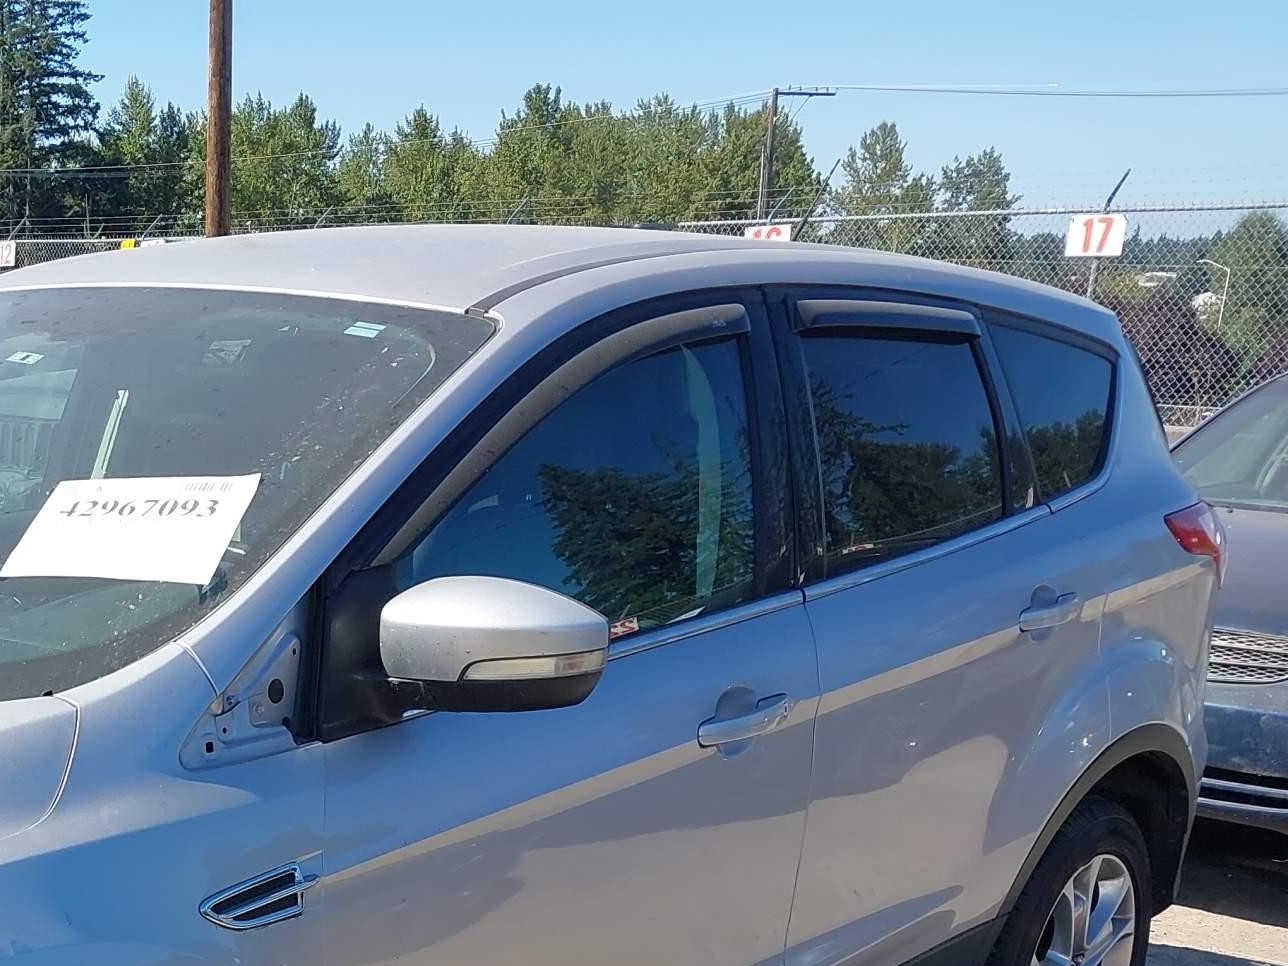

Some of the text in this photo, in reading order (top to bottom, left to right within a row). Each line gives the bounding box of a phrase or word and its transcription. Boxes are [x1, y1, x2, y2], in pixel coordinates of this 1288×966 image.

[1082, 217, 1114, 253] 17
[0, 245, 12, 265] 12
[59, 499, 220, 518] 42967093
